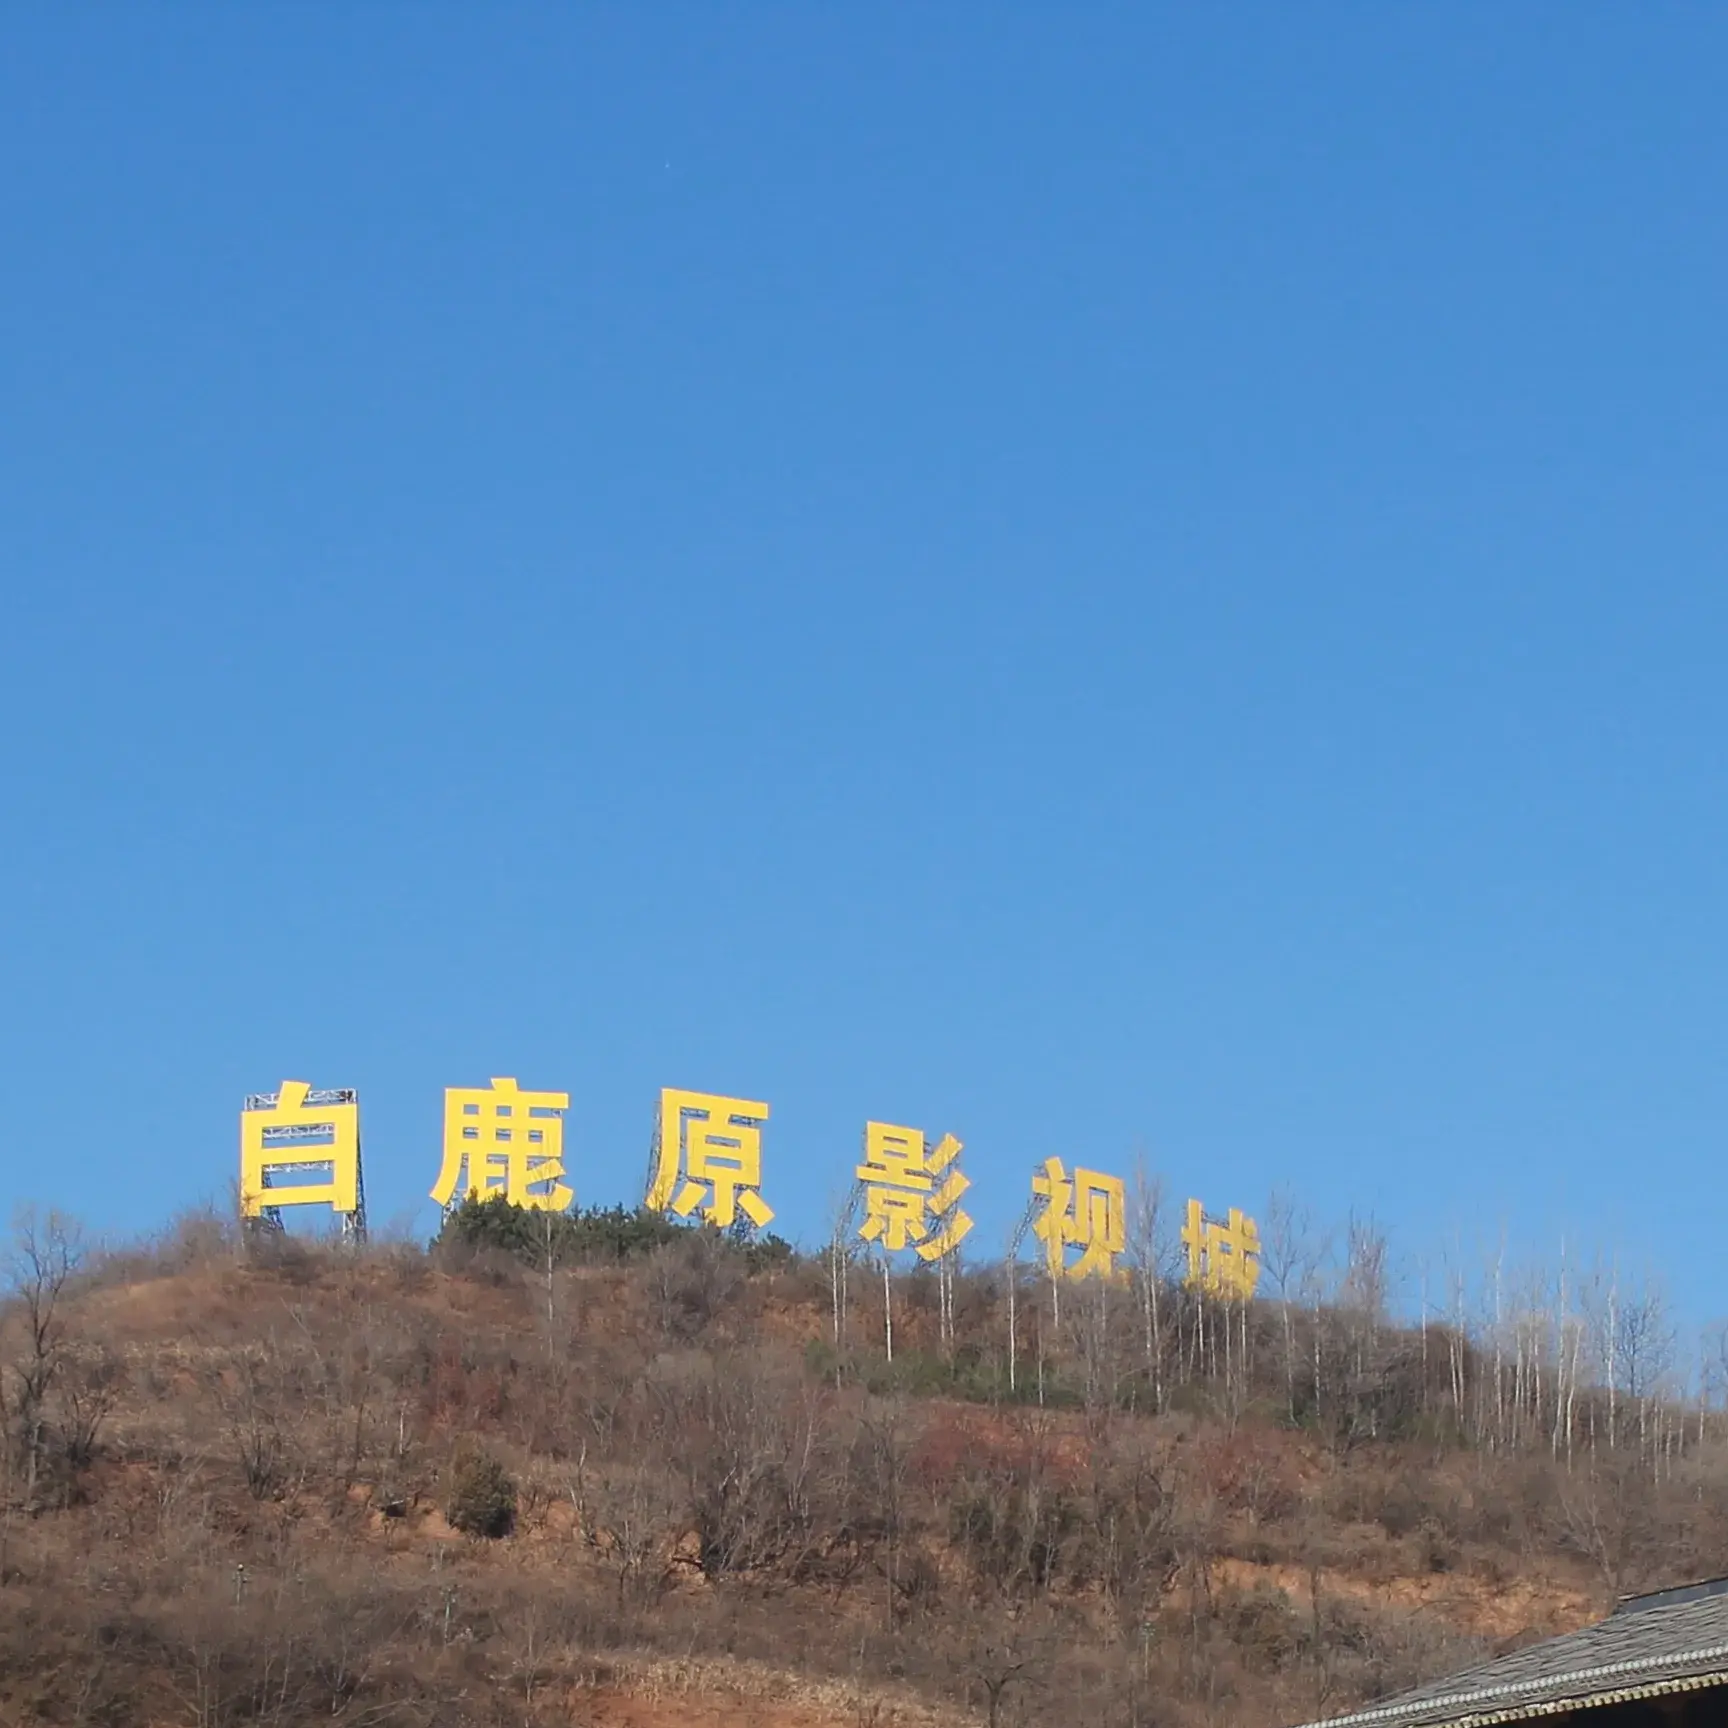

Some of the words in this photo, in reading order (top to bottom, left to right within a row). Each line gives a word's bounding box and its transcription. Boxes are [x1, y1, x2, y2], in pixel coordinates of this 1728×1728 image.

[240, 1077, 1262, 1301] 白鹿原影视城
